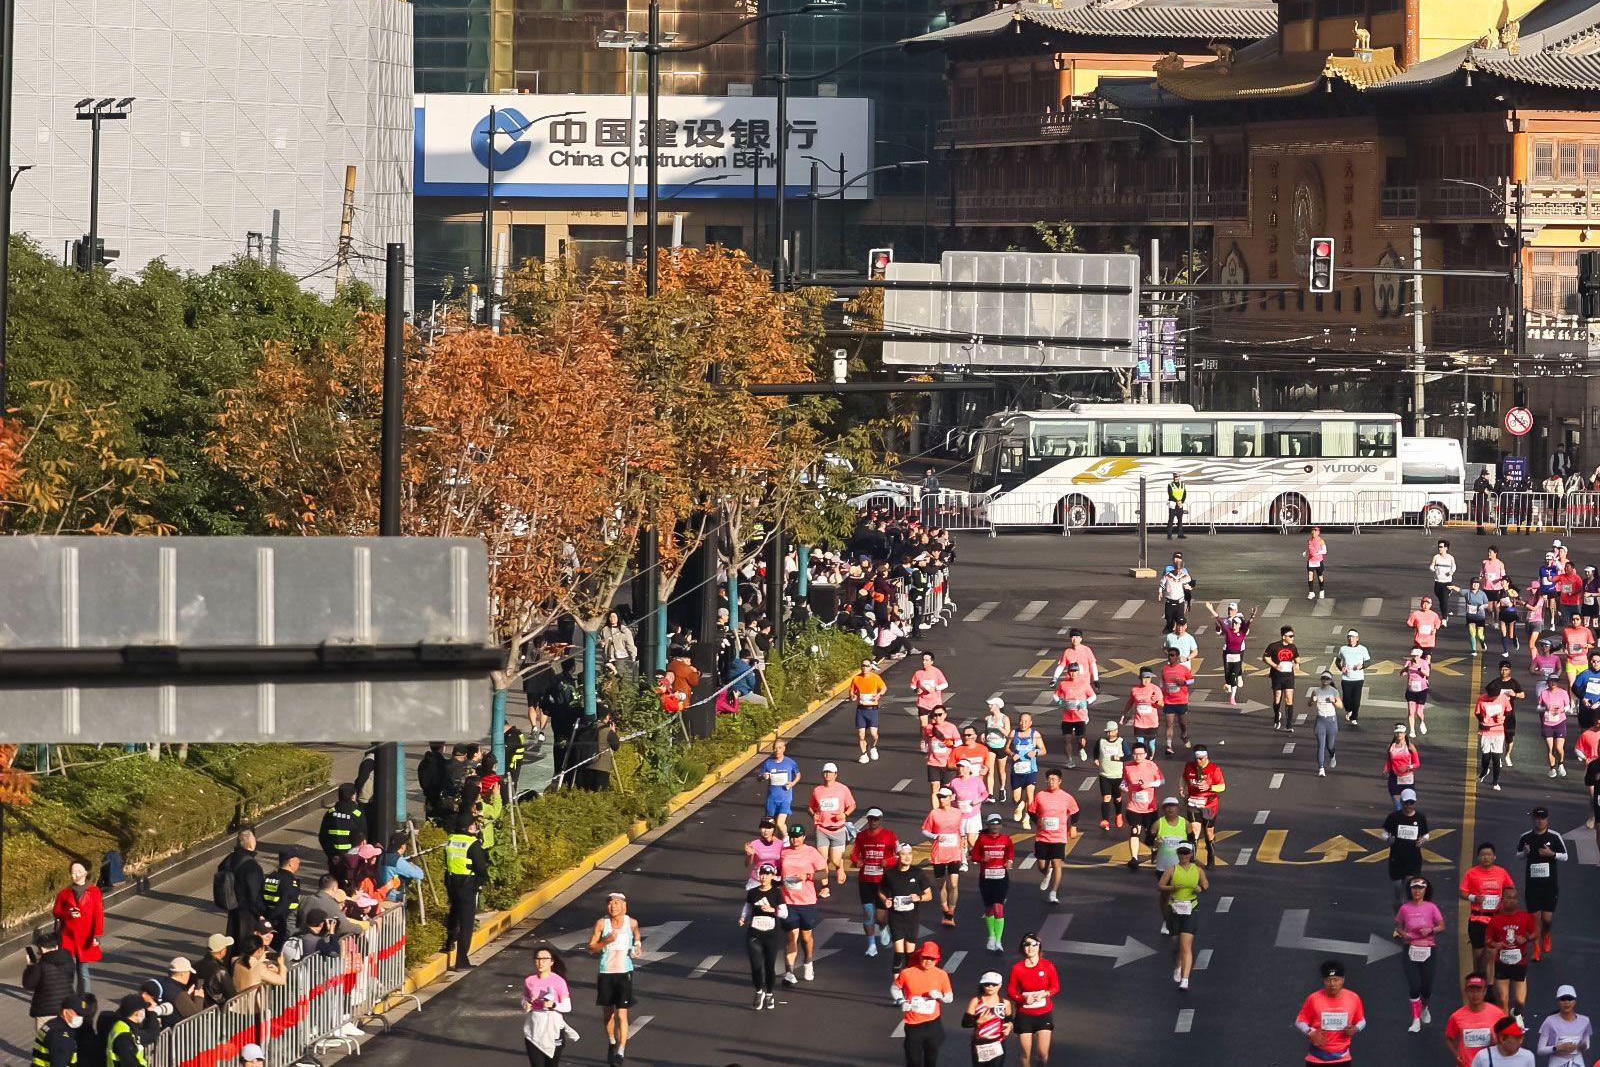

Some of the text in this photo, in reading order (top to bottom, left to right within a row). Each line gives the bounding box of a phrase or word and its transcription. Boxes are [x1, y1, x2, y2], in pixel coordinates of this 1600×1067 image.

[549, 118, 818, 149] 中国建设银行
[548, 150, 603, 167] China
[611, 151, 725, 168] Contruction
[1323, 464, 1378, 473] YUTONG
